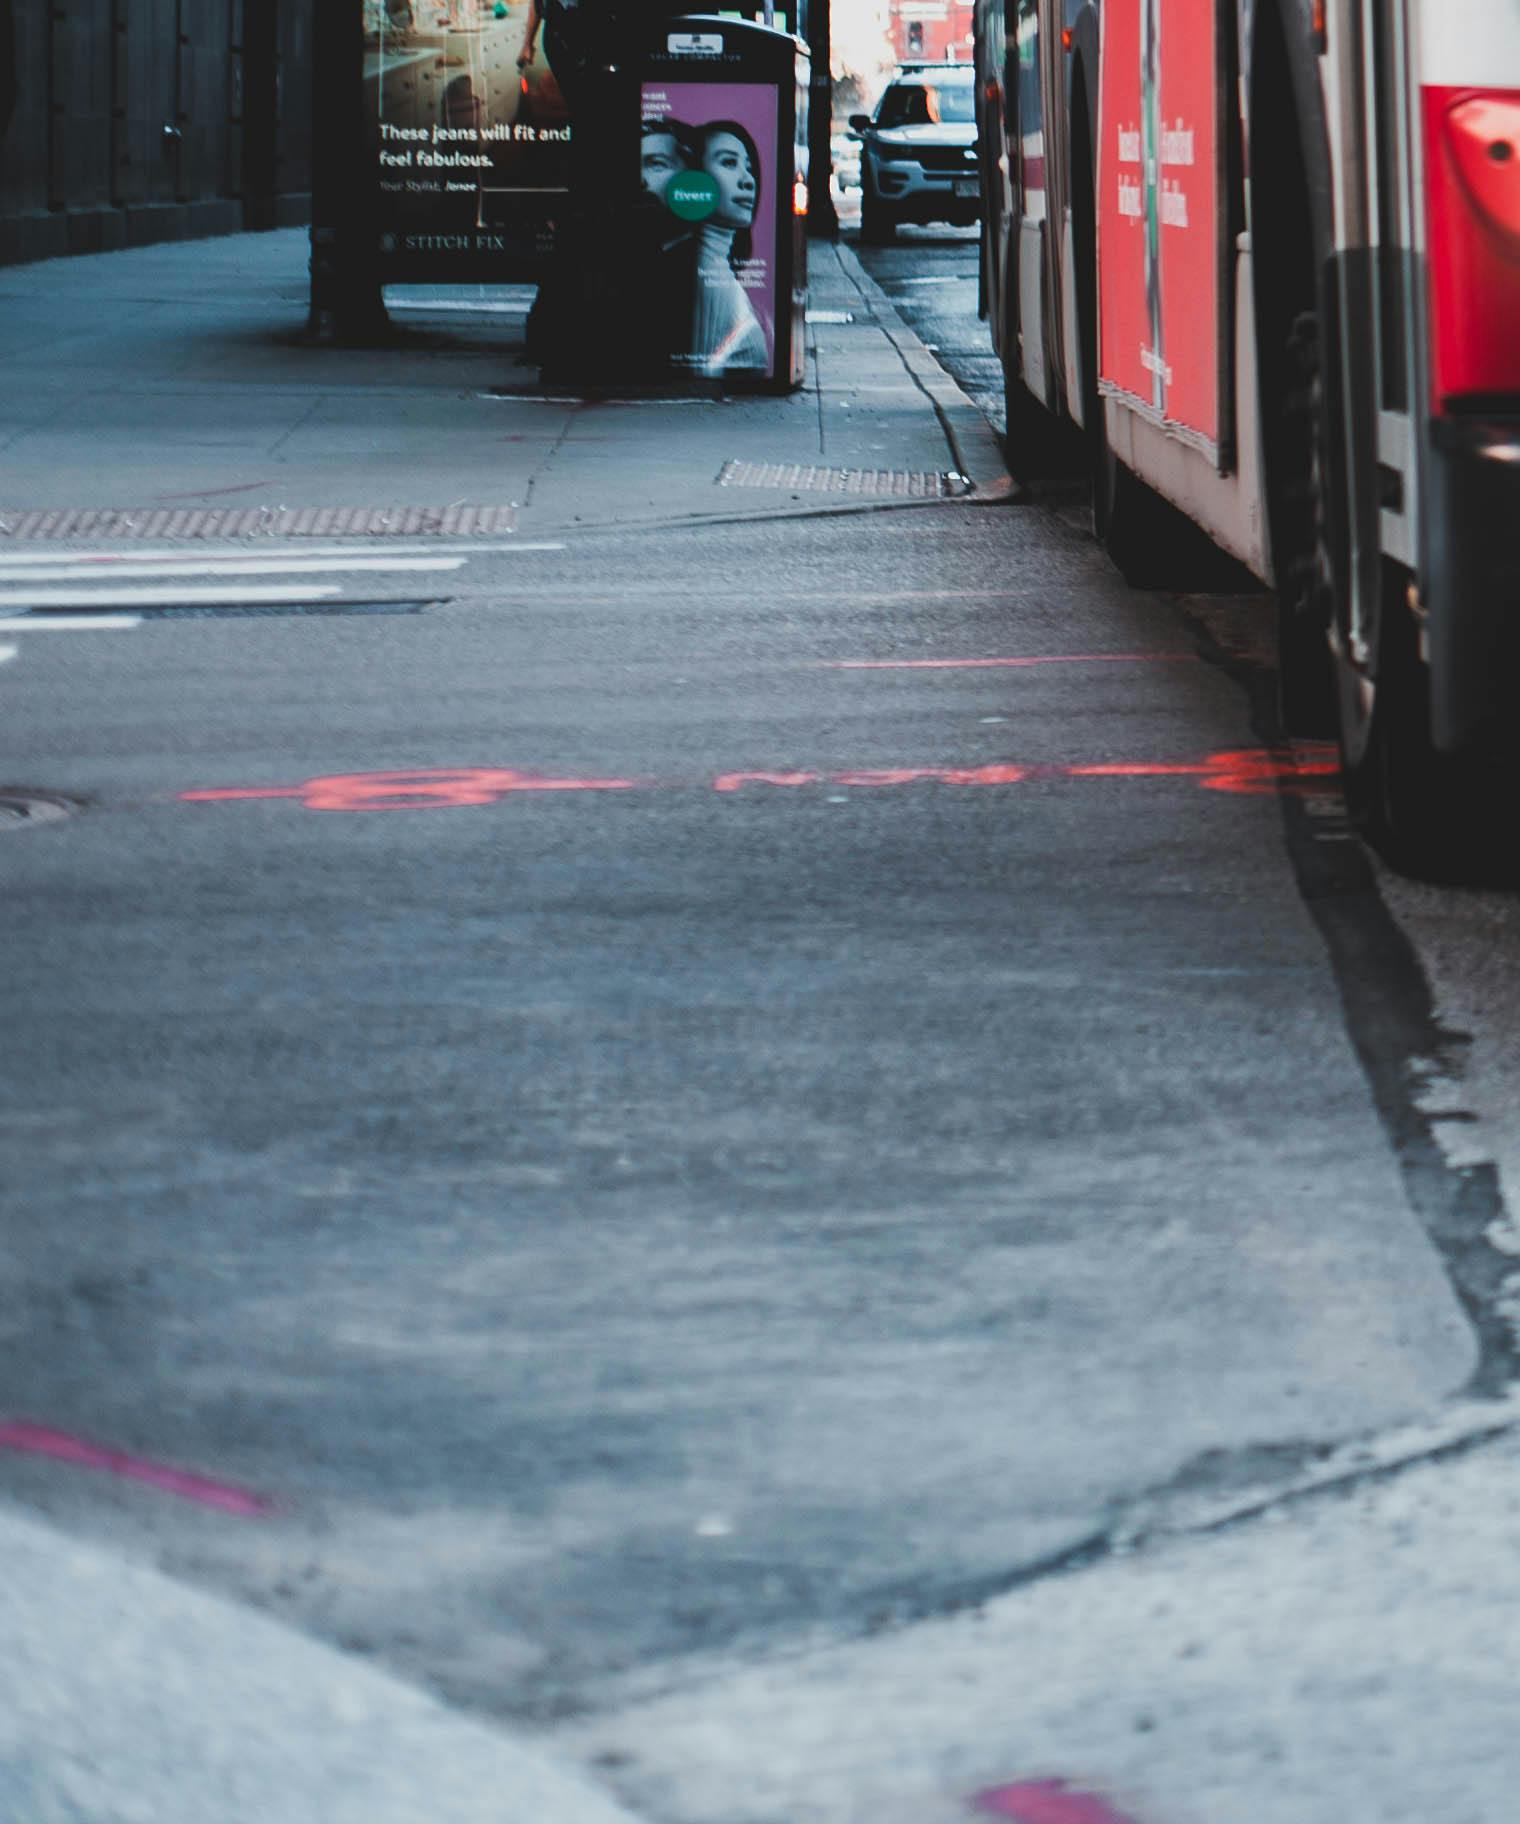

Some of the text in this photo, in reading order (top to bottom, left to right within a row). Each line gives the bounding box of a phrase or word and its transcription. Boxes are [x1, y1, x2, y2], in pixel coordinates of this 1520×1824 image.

[380, 124, 572, 145] These jeans will fit and
[379, 150, 495, 167] feel fabulous.
[405, 235, 505, 250] STITCH FIX
